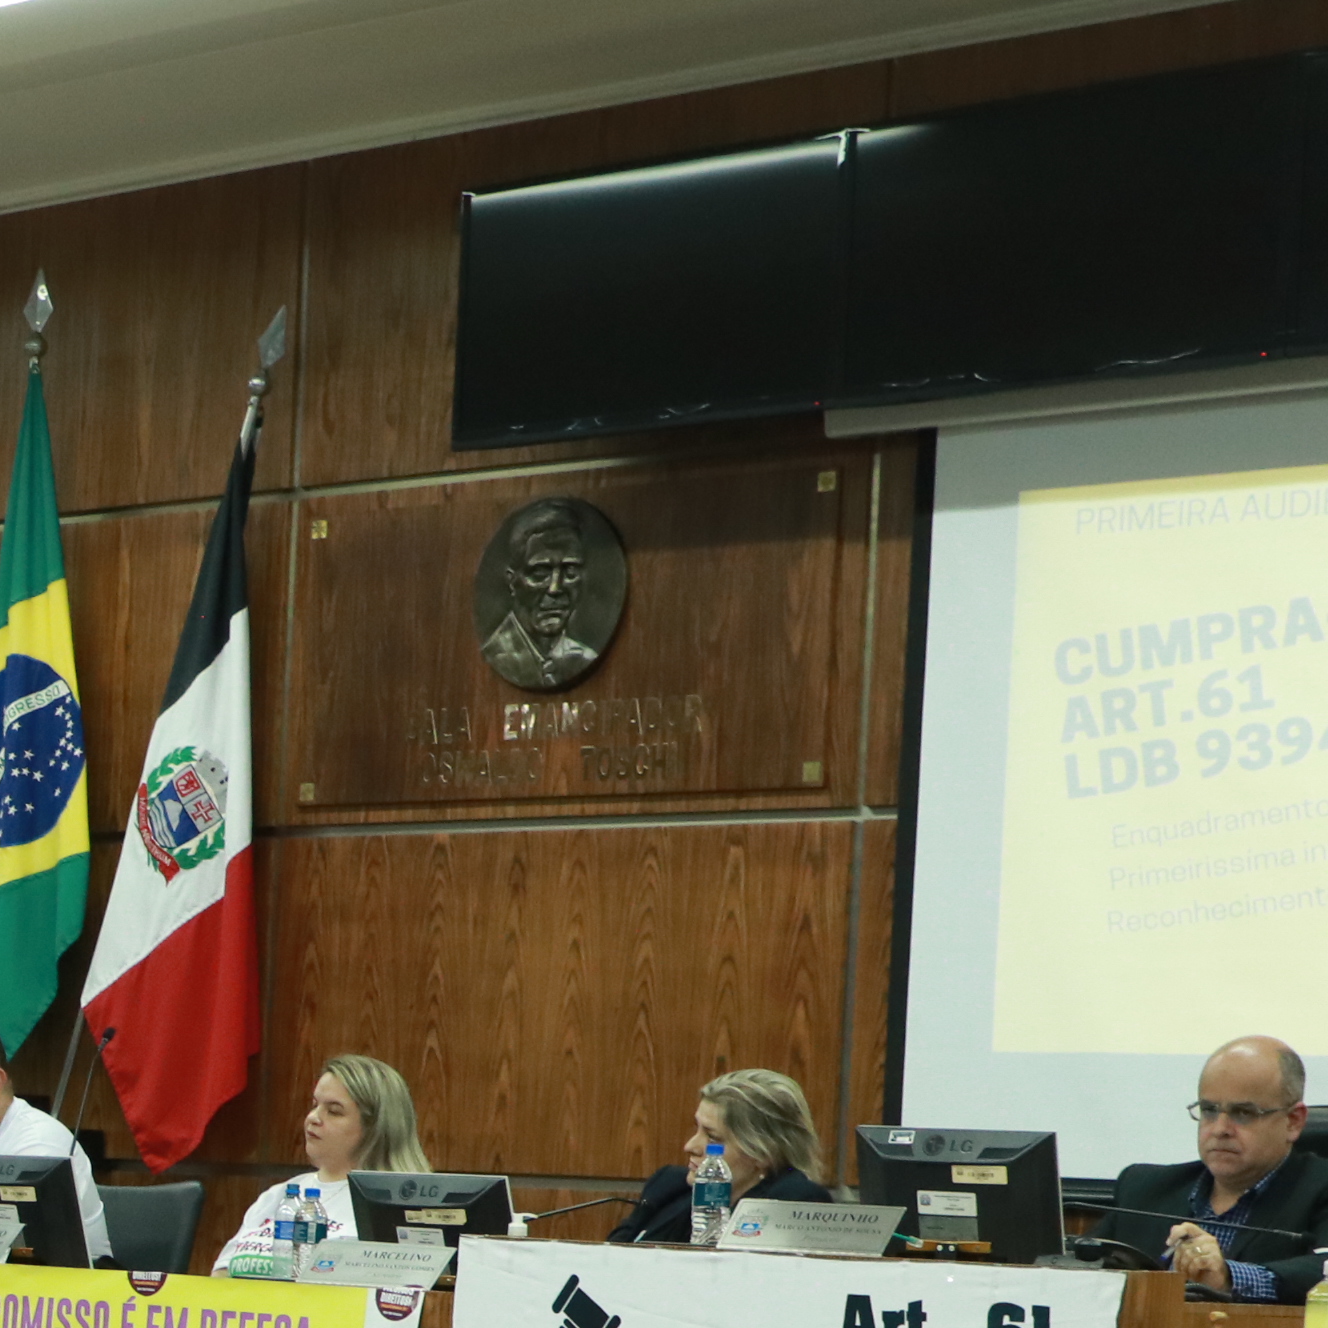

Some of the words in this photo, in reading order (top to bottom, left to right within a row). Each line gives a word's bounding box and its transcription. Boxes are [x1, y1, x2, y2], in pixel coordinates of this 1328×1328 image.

[1075, 493, 1231, 535] PRIMEIRA
[1055, 596, 1328, 687] CUMPRA
[1060, 664, 1275, 744] ART.61
[1064, 738, 1181, 798] LDB
[949, 1138, 973, 1154] LG
[0, 1164, 16, 1176] LG
[419, 1184, 440, 1198] LG
[790, 1211, 879, 1223] MARQUINHO
[362, 1249, 432, 1262] MARCELINO
